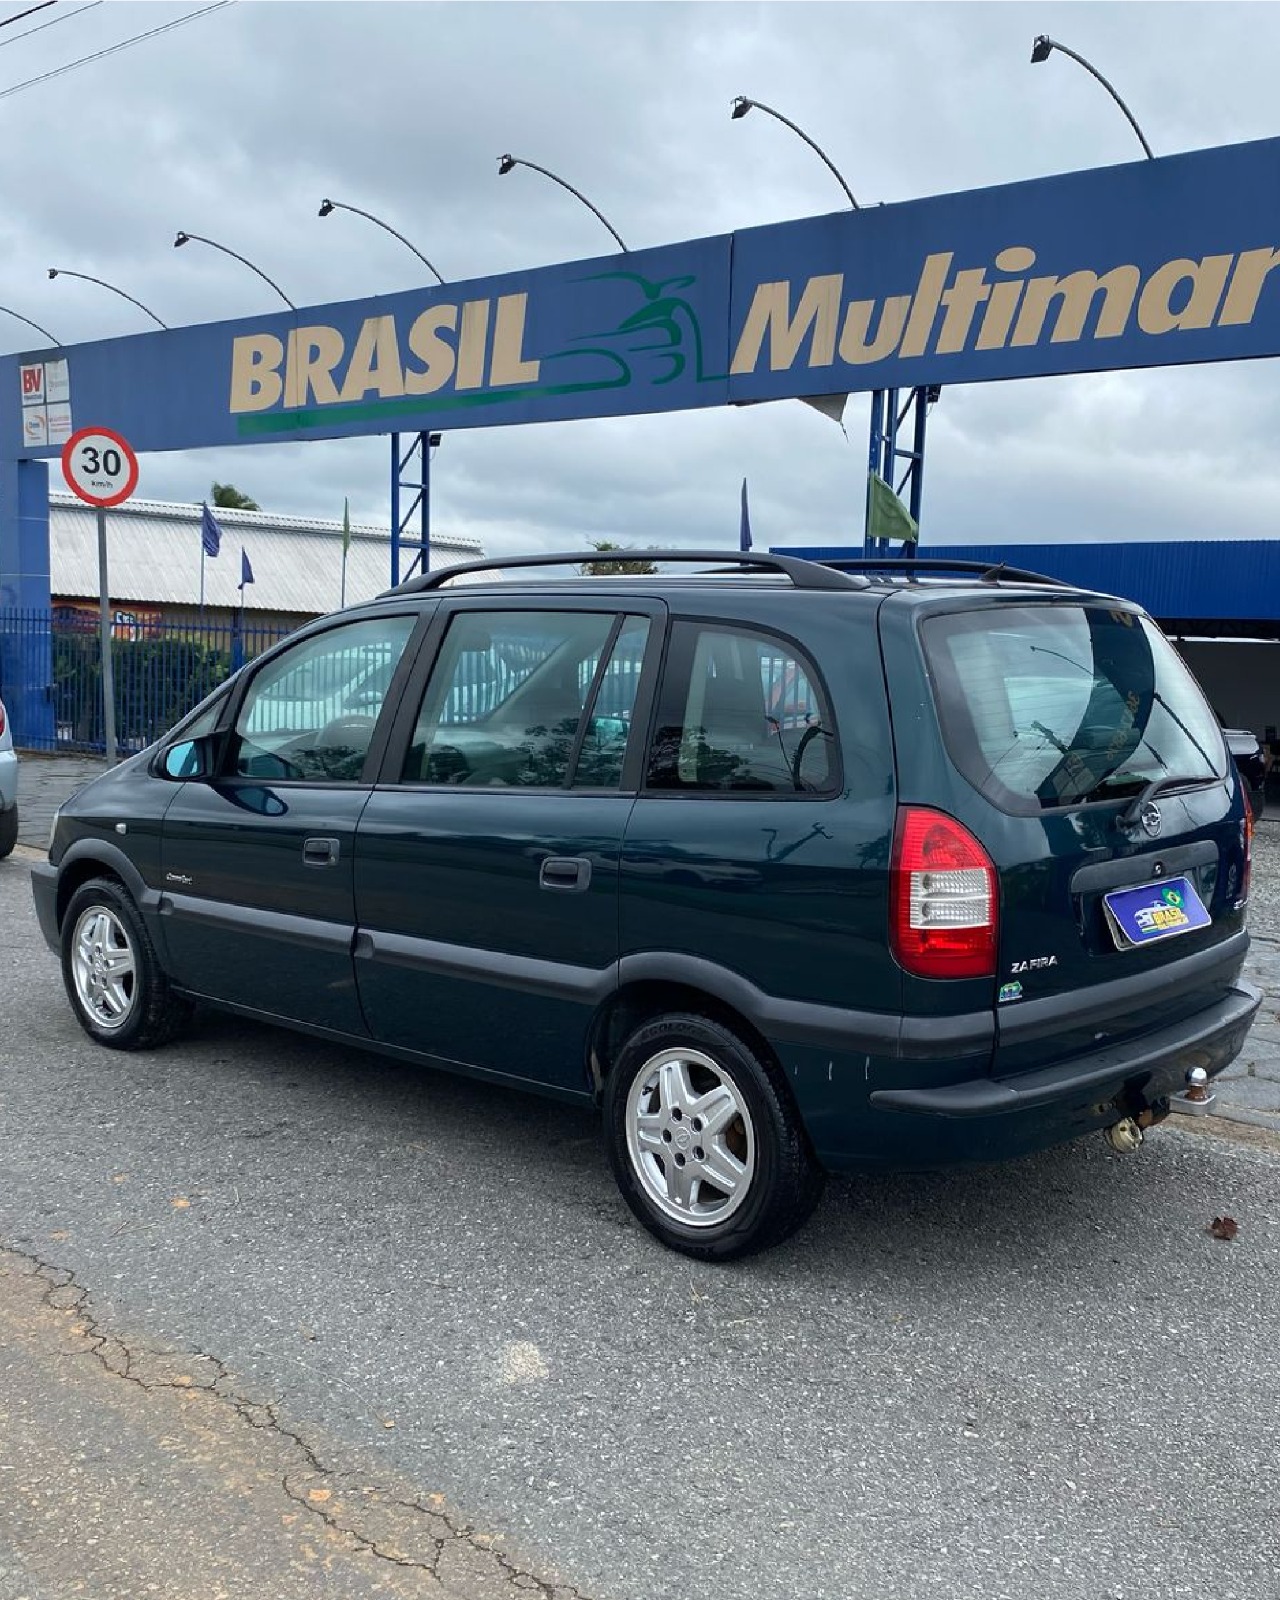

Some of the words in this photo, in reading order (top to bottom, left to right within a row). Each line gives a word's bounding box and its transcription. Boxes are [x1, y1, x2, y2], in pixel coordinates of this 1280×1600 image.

[230, 293, 541, 413] BRASIL
[23, 369, 42, 394] BV
[81, 446, 121, 476] 30
[91, 480, 113, 488] km/h
[1011, 955, 1058, 973] ZAFIRA
